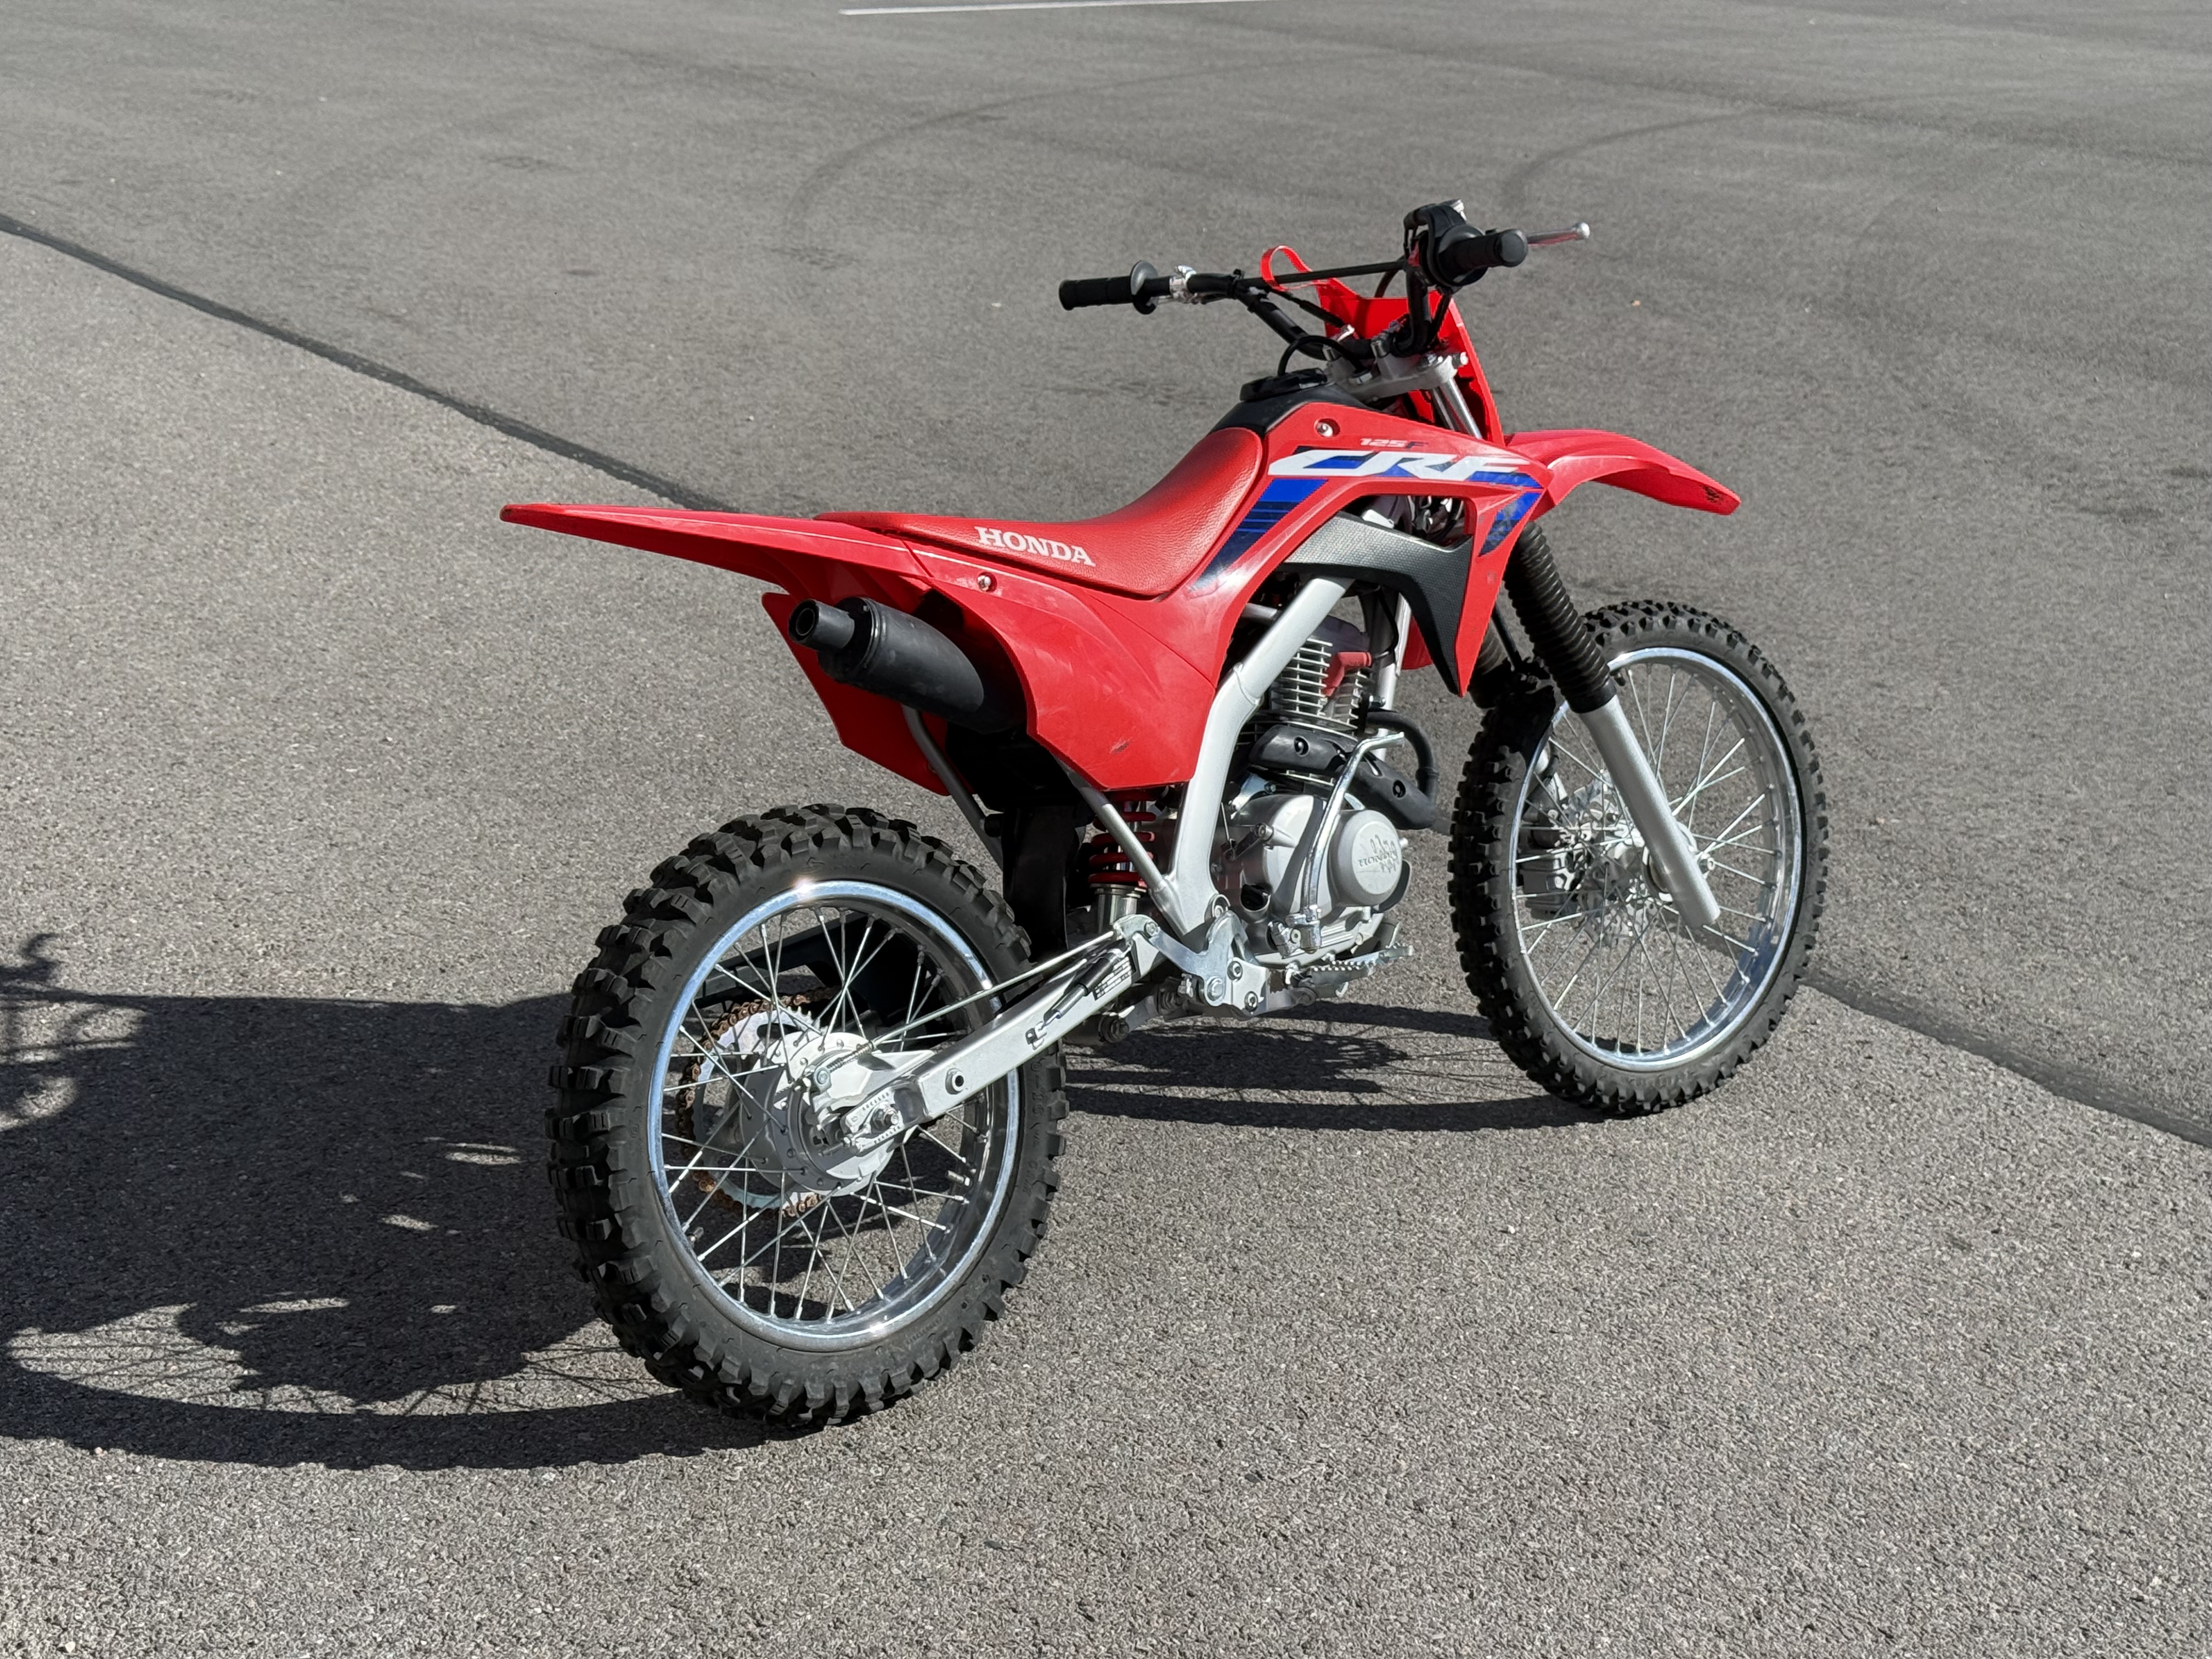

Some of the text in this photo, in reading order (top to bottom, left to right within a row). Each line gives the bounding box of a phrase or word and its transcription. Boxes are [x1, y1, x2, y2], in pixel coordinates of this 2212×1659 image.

[1360, 438, 1429, 449] 125F
[1268, 449, 1530, 481] CRF
[974, 526, 1096, 567] HONDA
